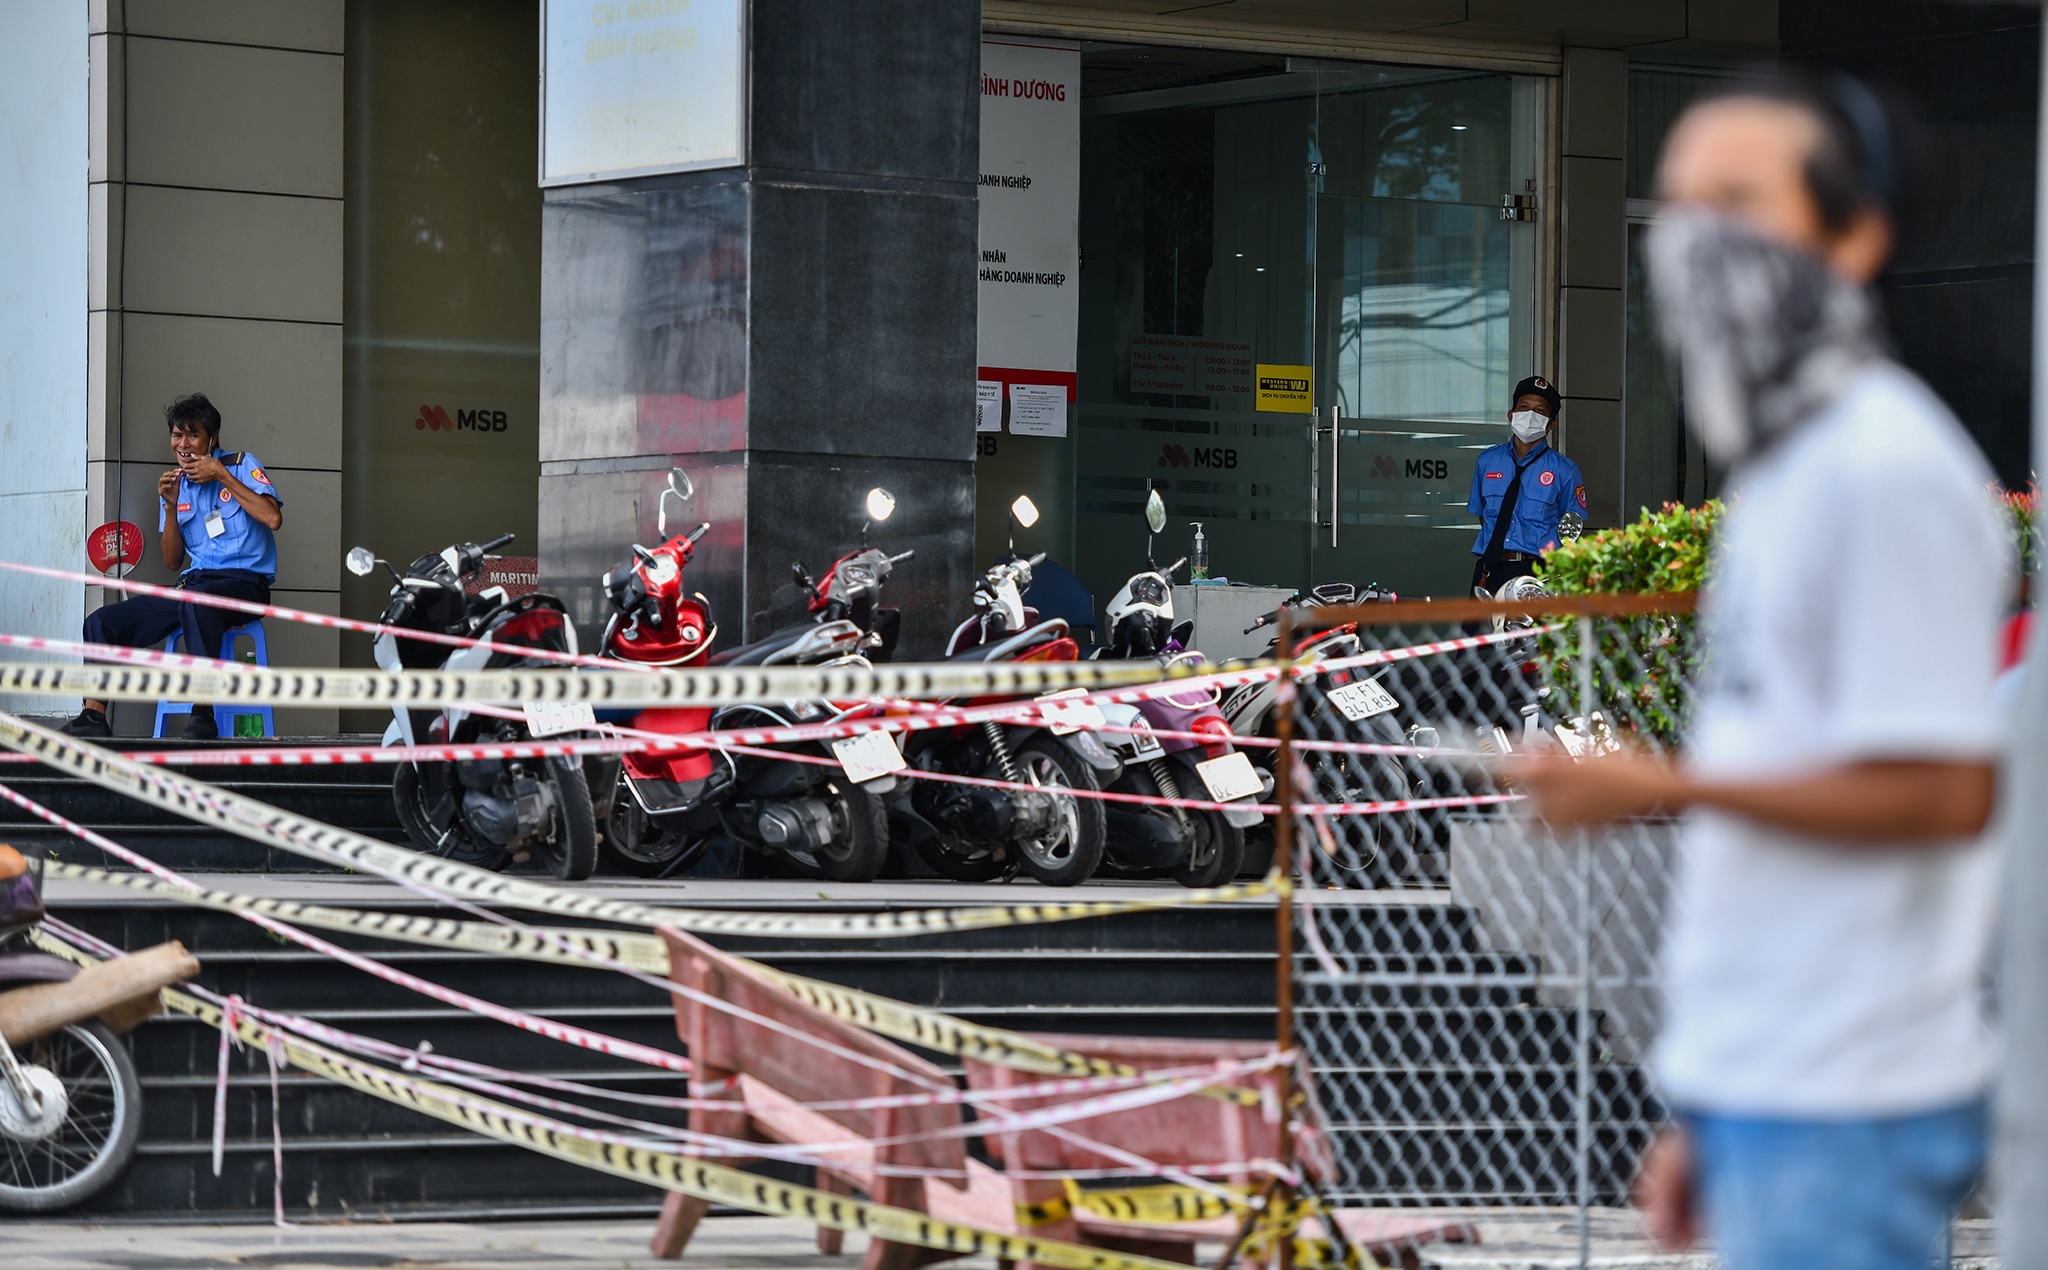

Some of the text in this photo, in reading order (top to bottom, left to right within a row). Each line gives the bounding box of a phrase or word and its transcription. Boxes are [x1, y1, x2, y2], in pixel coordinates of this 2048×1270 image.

[1013, 79, 1066, 102] DƯƠNG
[1001, 175, 1032, 191] NGHIỆP
[982, 249, 1006, 263] NHÂN
[979, 267, 1066, 288] HÀNG DOANH NGHIỆP
[1147, 337, 1166, 346] GIAO
[1190, 341, 1225, 350] WORKING
[1226, 343, 1251, 352] HOURS
[1132, 362, 1159, 372] Monday
[1164, 364, 1186, 373] Friday
[457, 408, 508, 432] MSB
[1193, 446, 1238, 469] MSB
[1405, 458, 1449, 480] MSB
